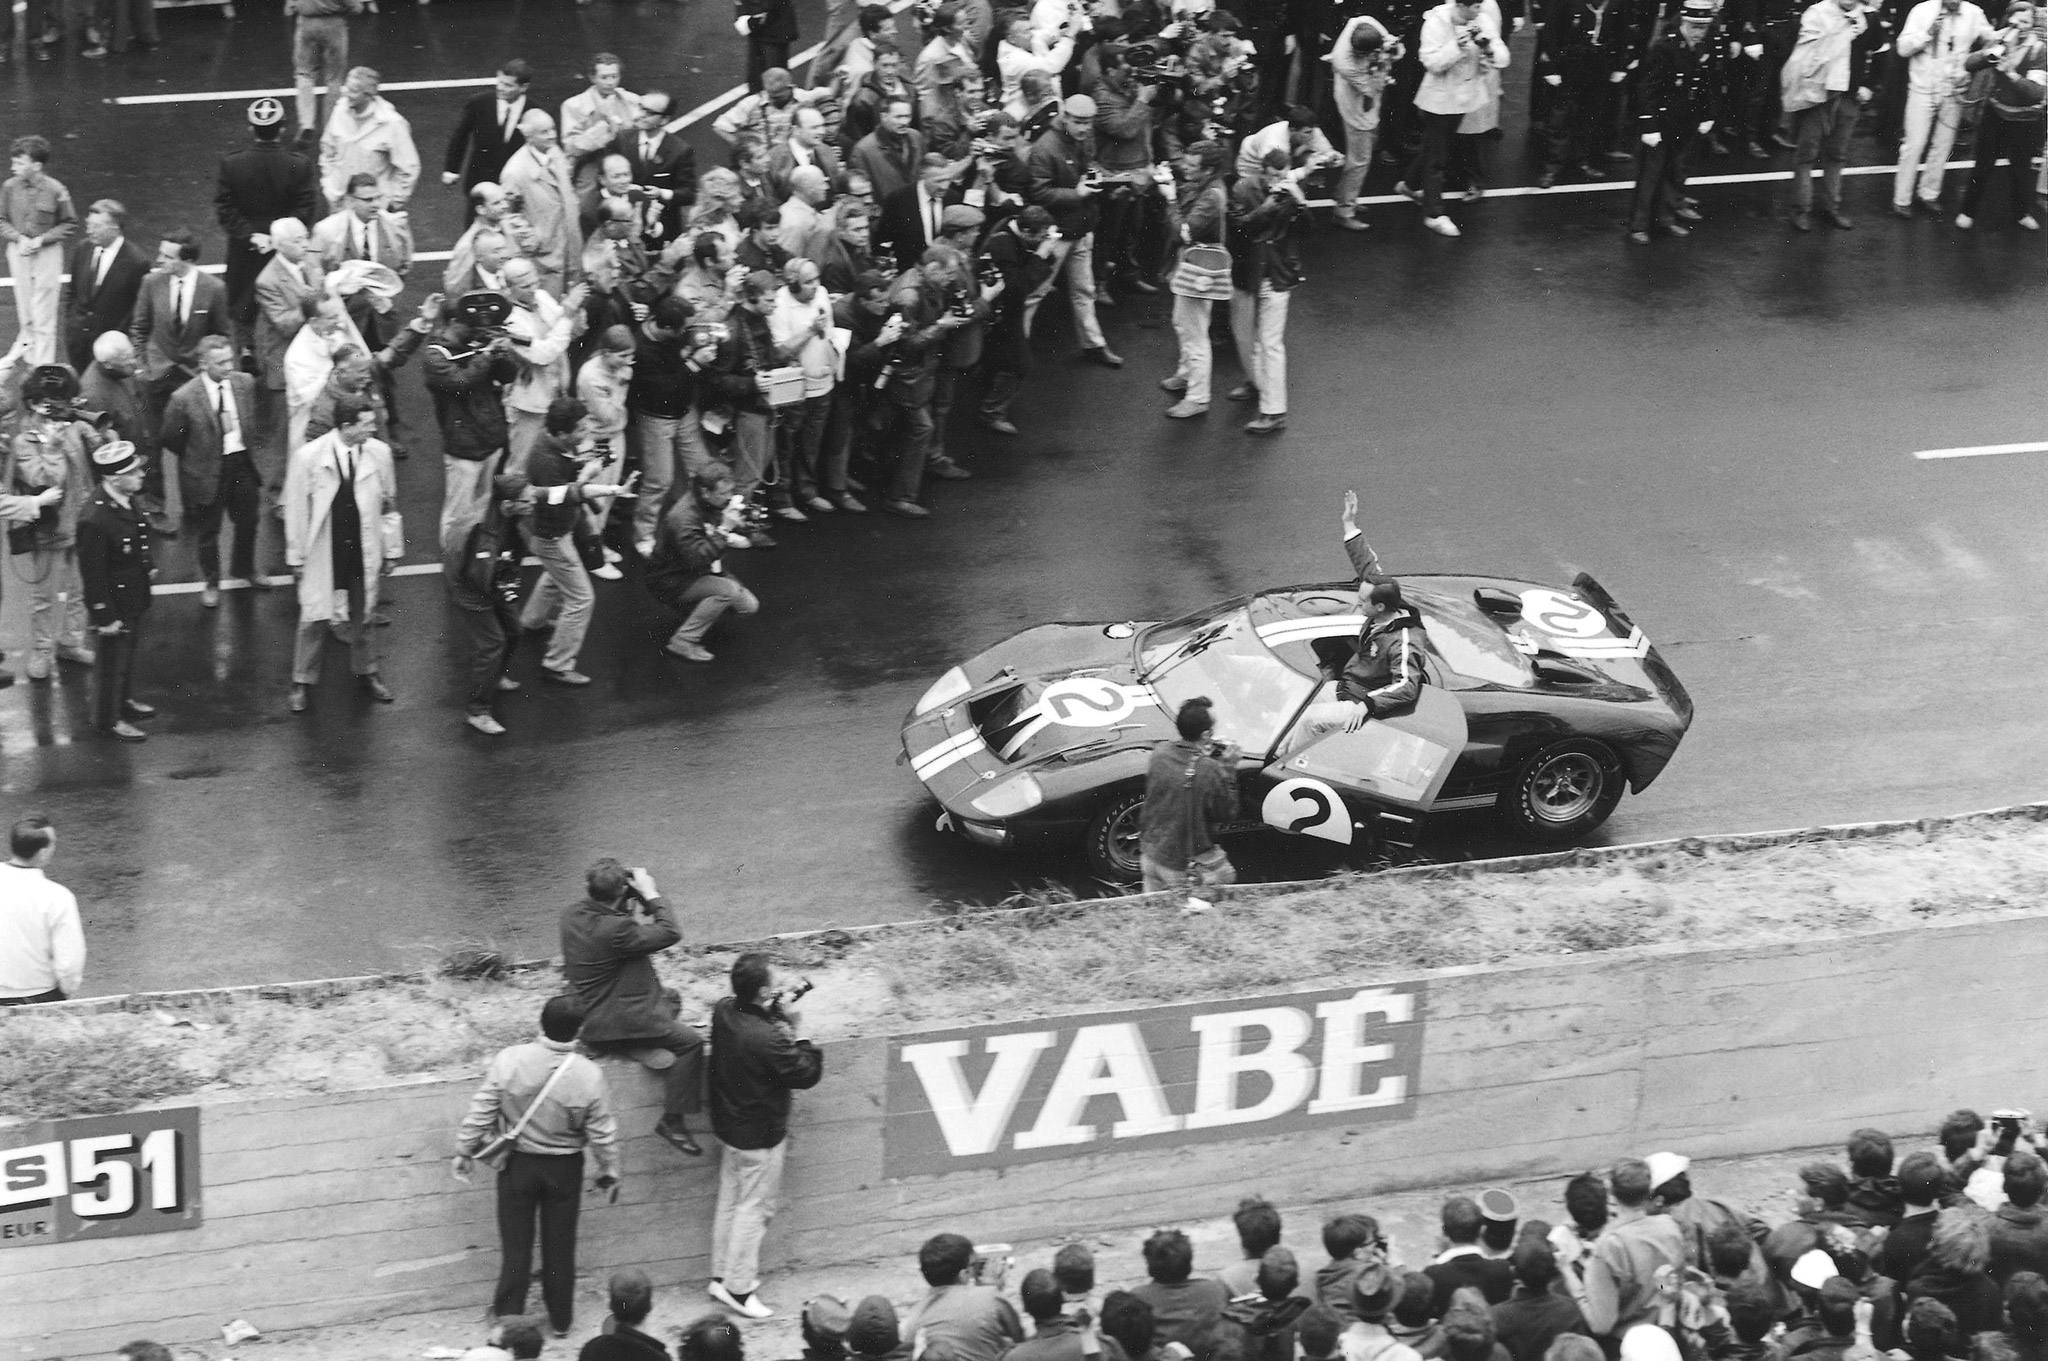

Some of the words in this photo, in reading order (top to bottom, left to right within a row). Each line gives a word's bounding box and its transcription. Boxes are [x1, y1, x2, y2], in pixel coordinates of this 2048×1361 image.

[1540, 596, 1592, 633] 2
[1047, 686, 1125, 720] 2
[1288, 786, 1331, 834] 2
[902, 988, 1414, 1156] VABÉ
[70, 1129, 178, 1217] 51
